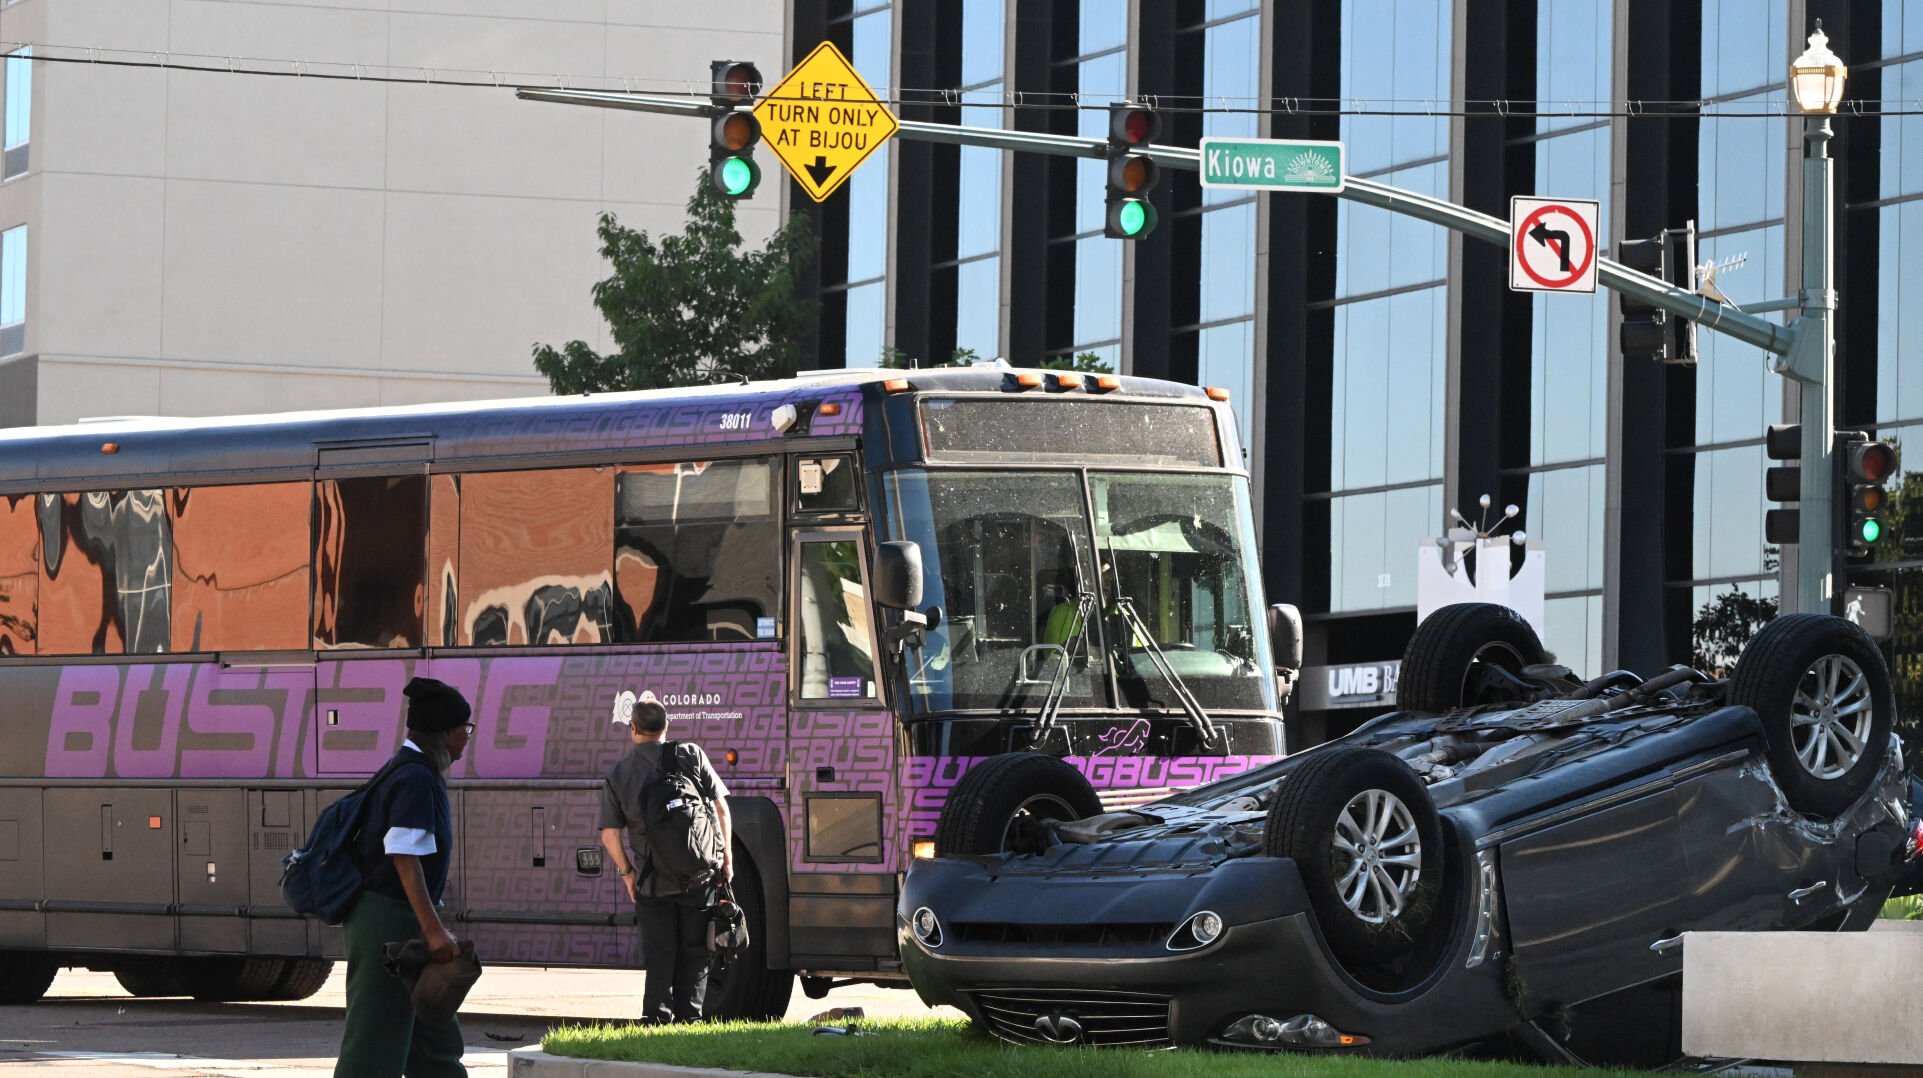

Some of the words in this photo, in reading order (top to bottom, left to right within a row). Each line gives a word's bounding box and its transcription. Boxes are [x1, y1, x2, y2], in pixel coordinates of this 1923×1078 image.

[800, 81, 848, 100] LEFT
[767, 103, 819, 123] TURN
[829, 107, 878, 126] ONLY
[776, 129, 800, 146] AT
[810, 130, 867, 150] BIJOU
[1208, 149, 1275, 178] Kiowa
[1290, 158, 1330, 176] DOWNTOWN
[719, 413, 751, 430] 38011
[1378, 573, 1391, 588] 101
[1328, 666, 1378, 697] UMB
[663, 694, 721, 705] COLORADO
[696, 711, 701, 719] of
[702, 711, 743, 721] Transportation
